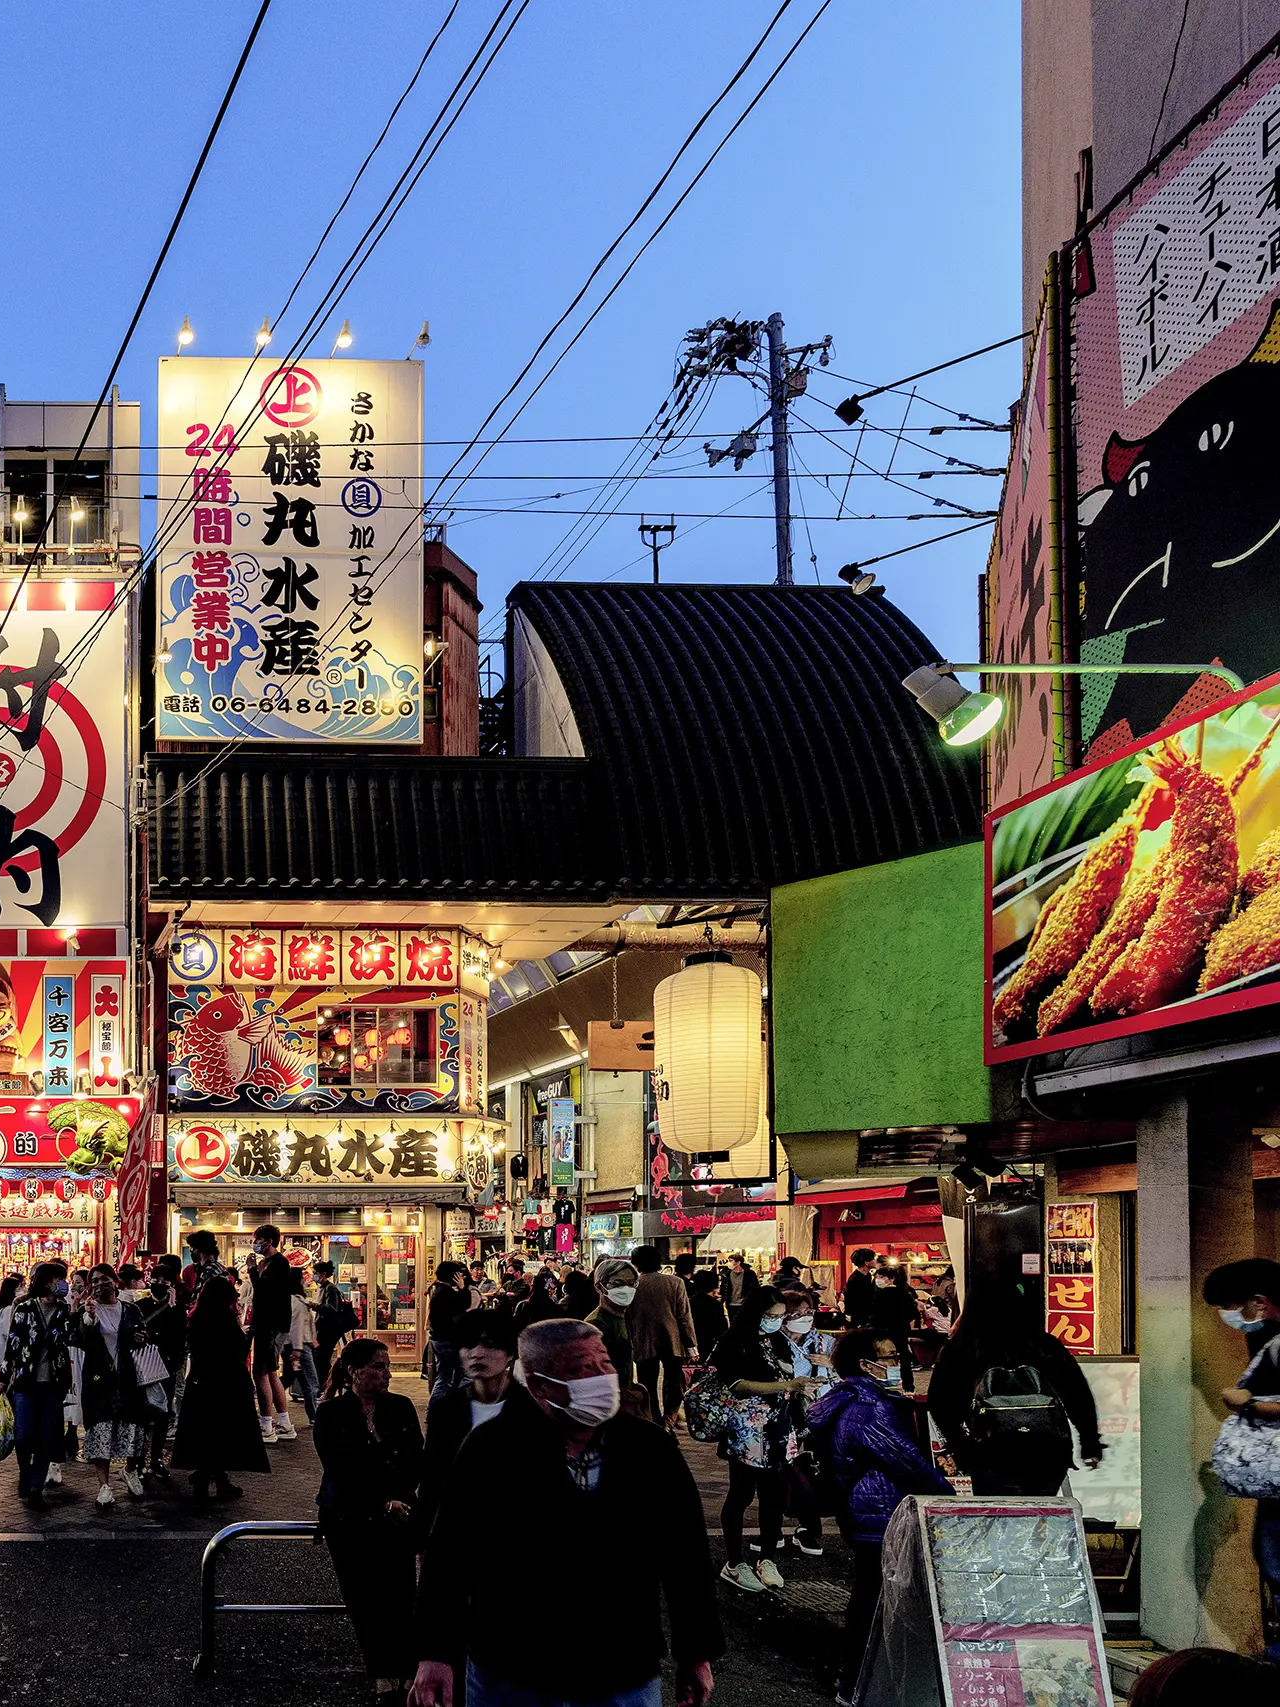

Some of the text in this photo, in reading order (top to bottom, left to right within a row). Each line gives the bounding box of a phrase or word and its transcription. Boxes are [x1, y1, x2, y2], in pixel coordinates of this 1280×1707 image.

[1193, 162, 1232, 325] チューハイ
[1134, 223, 1170, 385] ハイボール
[185, 423, 240, 672] 24時間営業中
[261, 430, 321, 677] 磯丸水産
[164, 695, 414, 716] 電話 06-6484-2850
[229, 934, 453, 982] 海鮮浜焼
[48, 985, 70, 1086] 千客万来
[232, 1130, 438, 1178] 磯丸水産
[1048, 1207, 1093, 1238] 土日祝
[966, 1672, 994, 1681] ソース
[969, 1685, 1005, 1696] しょうゆ
